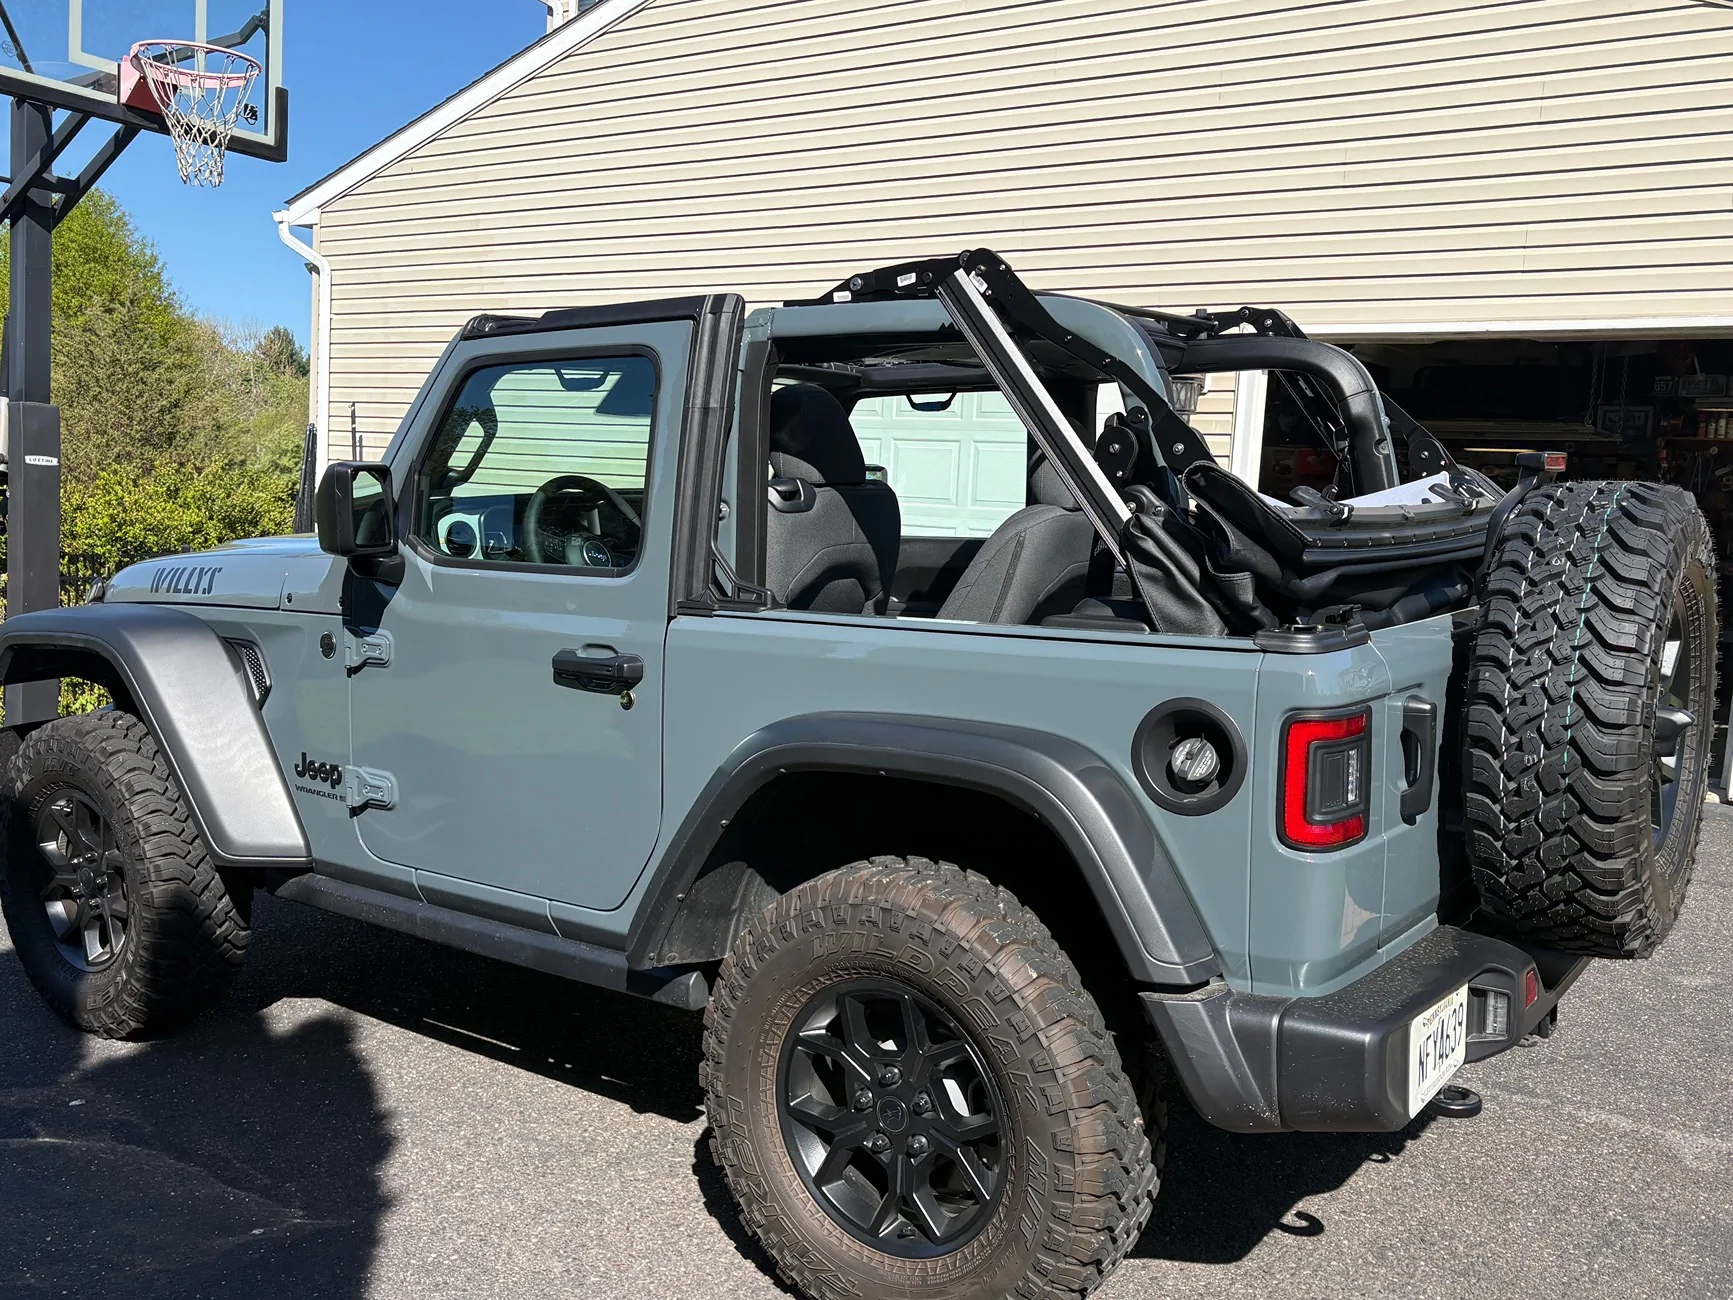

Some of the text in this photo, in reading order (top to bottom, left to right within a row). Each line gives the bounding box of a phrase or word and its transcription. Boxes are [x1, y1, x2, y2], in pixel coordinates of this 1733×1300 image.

[150, 567, 223, 594] WILLYS
[294, 752, 342, 789] Jeep
[295, 784, 338, 801] WRANGLER
[811, 931, 1040, 1111] WILDPEAK
[726, 1094, 862, 1297] FALKEN
[1018, 1136, 1048, 1252] M/T
